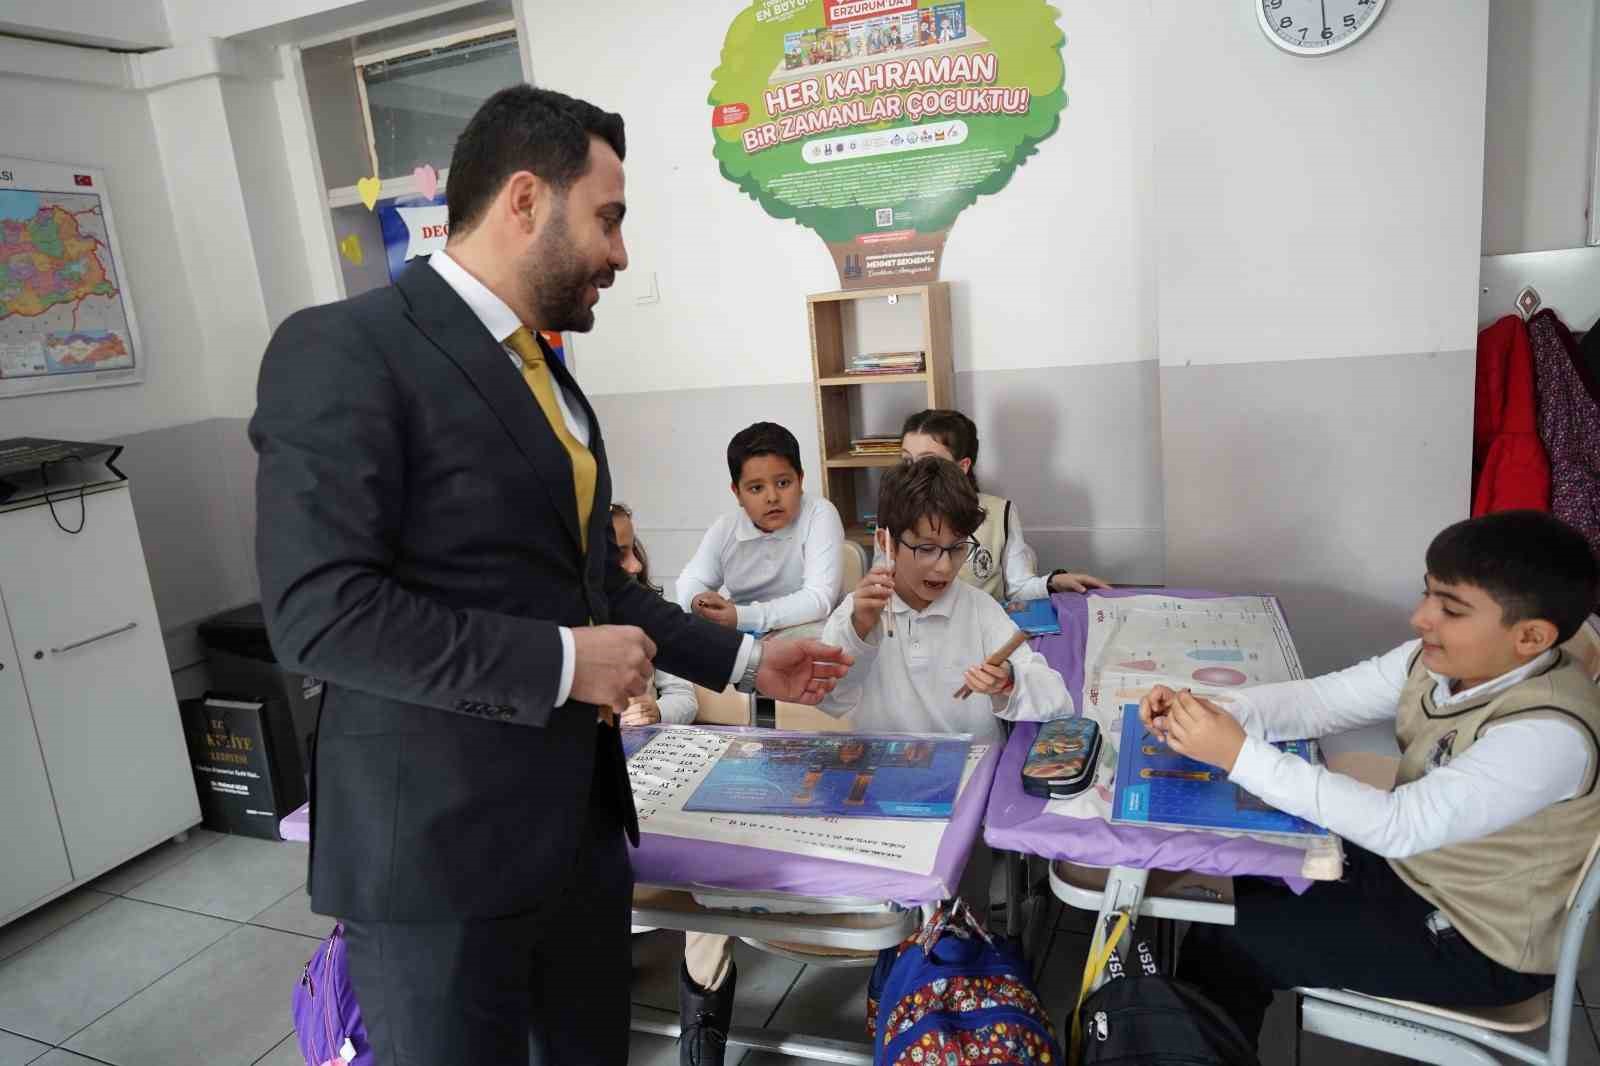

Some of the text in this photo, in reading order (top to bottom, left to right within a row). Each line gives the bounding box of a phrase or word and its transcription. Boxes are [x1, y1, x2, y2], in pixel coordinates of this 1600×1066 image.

[1280, 16, 1293, 28] 8
[1343, 14, 1355, 27] 5
[1298, 28, 1308, 40] 7
[1320, 27, 1333, 39] 6
[765, 80, 819, 116] HER
[826, 54, 997, 99] KAHRAMAN
[743, 121, 778, 151] BİR
[780, 96, 902, 138] ZAMANLAR
[907, 88, 1028, 121] ÇOCUKTU!
[0, 171, 13, 181] SI
